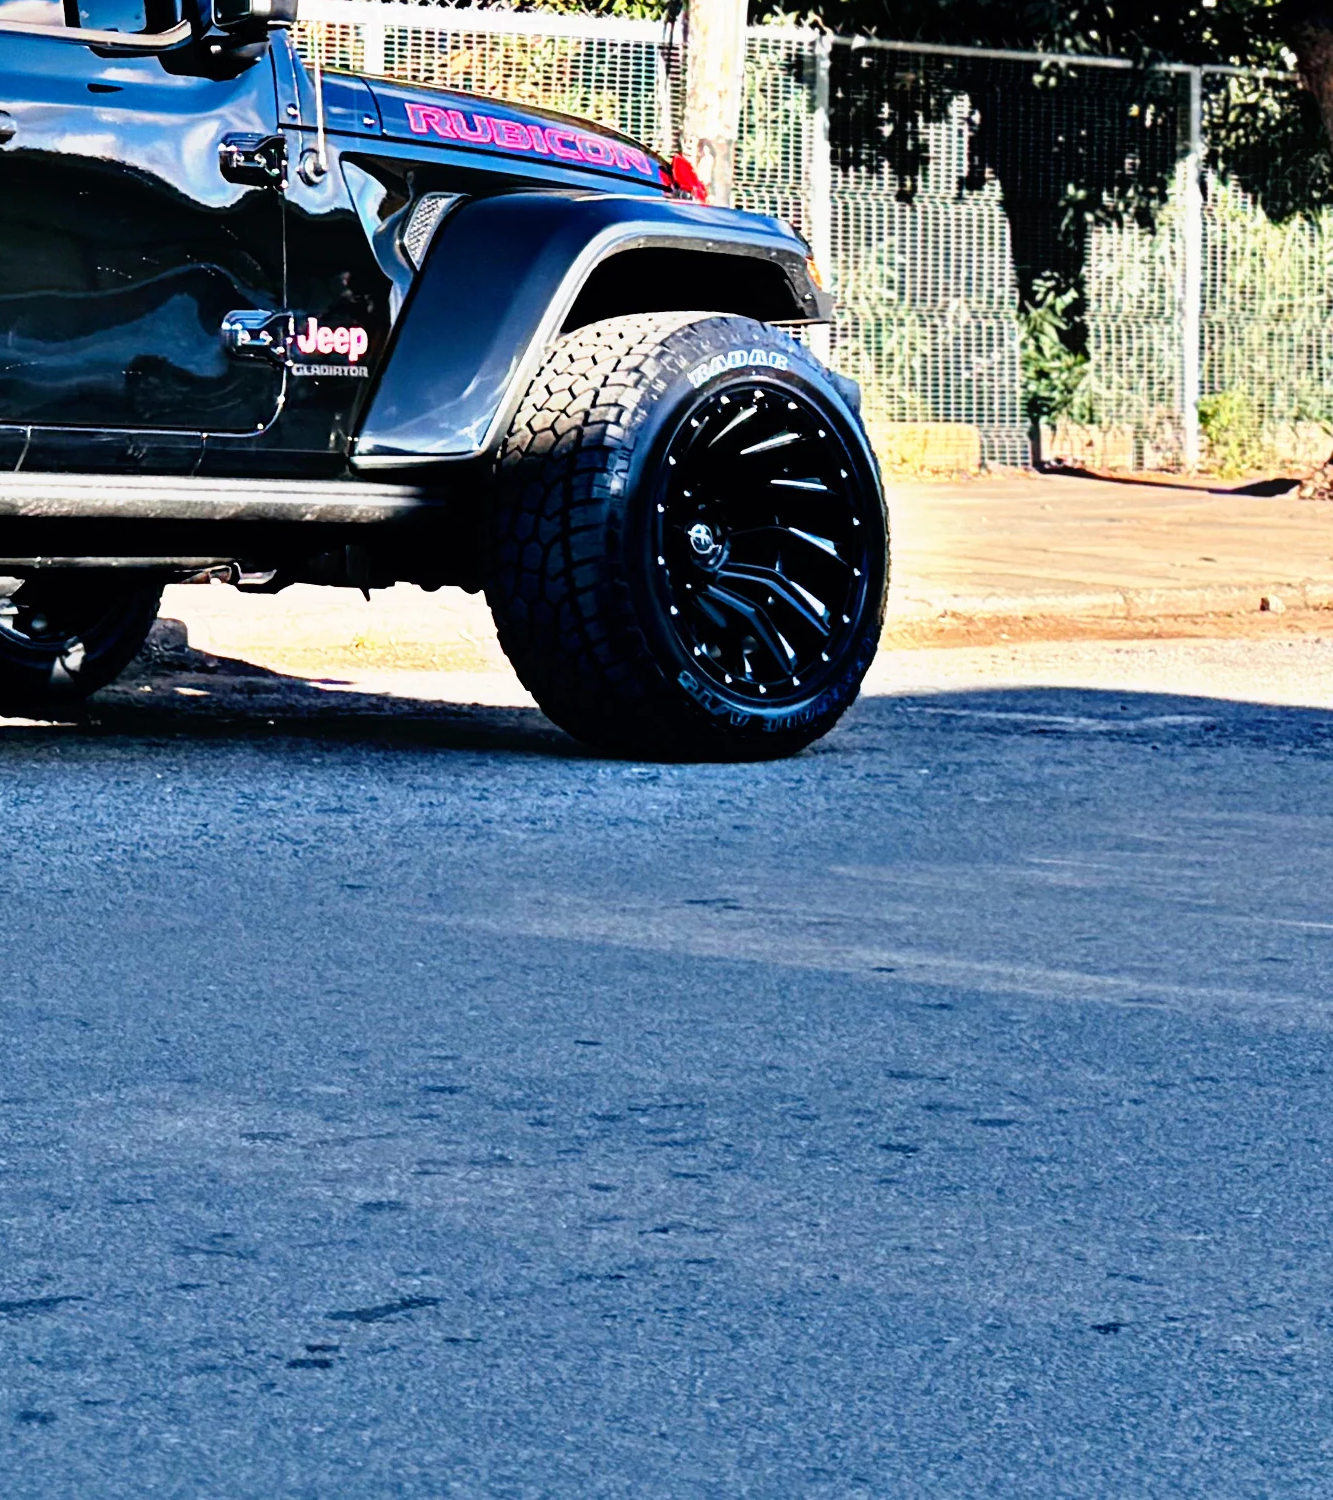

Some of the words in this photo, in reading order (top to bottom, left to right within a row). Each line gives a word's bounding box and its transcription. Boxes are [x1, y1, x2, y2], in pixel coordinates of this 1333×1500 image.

[404, 102, 652, 175] RUBICON
[297, 316, 369, 362] Jeep
[291, 363, 370, 378] GLADIATOR
[687, 348, 789, 389] RADAR
